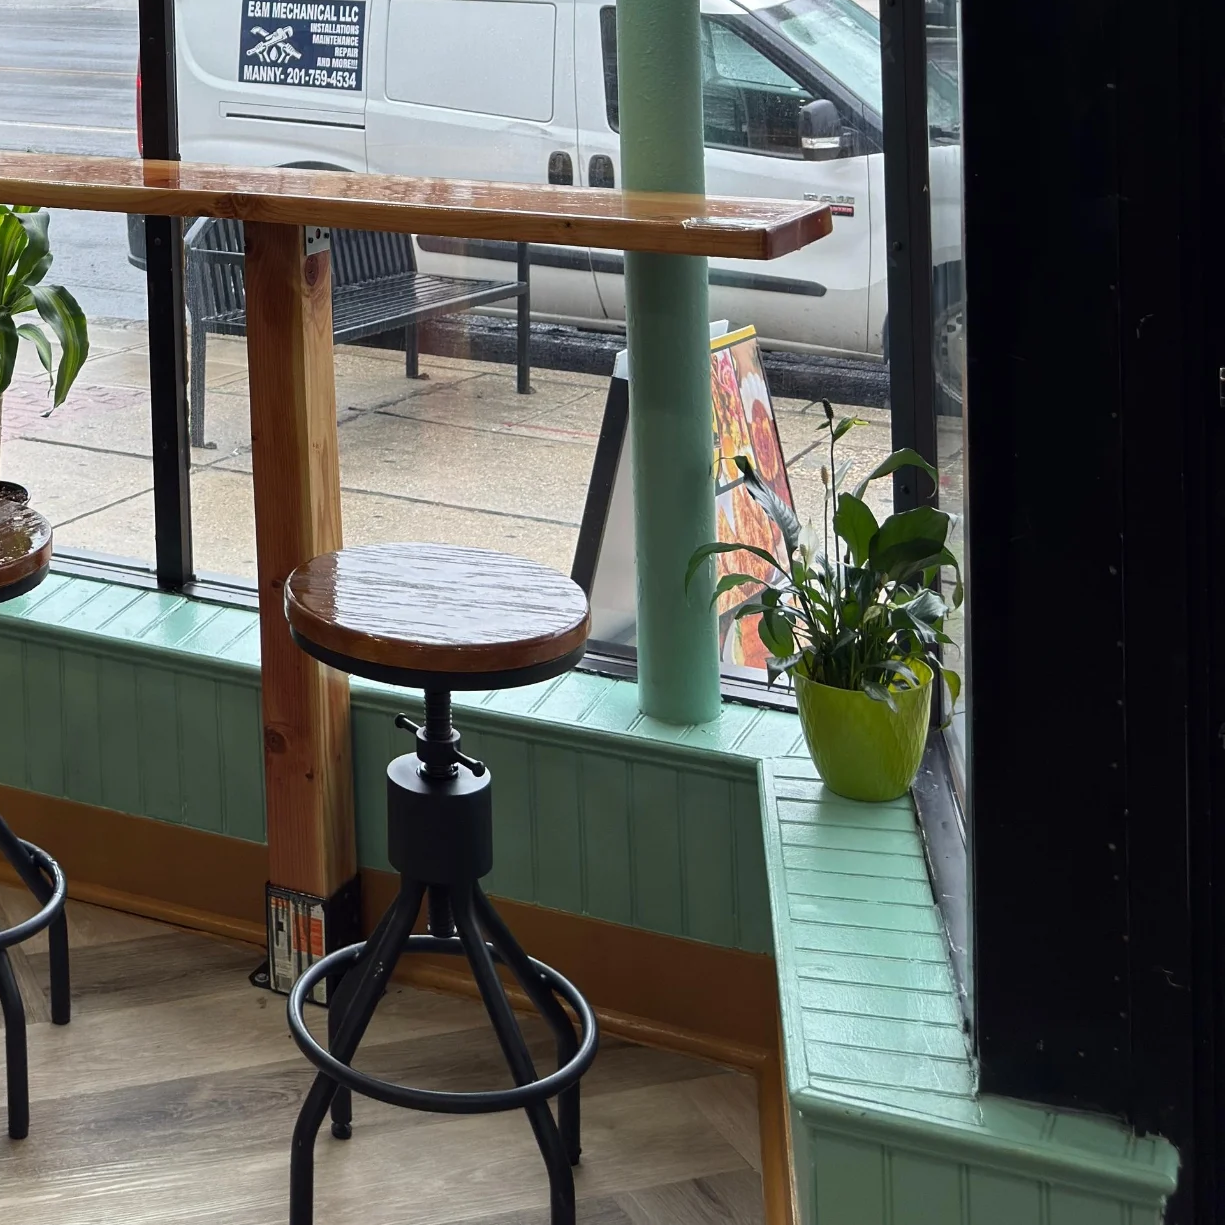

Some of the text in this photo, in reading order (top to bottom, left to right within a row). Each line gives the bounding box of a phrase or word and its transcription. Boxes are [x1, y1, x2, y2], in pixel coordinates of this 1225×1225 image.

[247, 0, 359, 22] E&M MECHANICAL LLC
[310, 22, 360, 35] INSTALLATIONS
[312, 34, 359, 46] MAINTENANCE
[334, 46, 359, 58] REPAIR
[316, 56, 358, 70] AND MORE!!!
[286, 67, 356, 88] 201-759-4534
